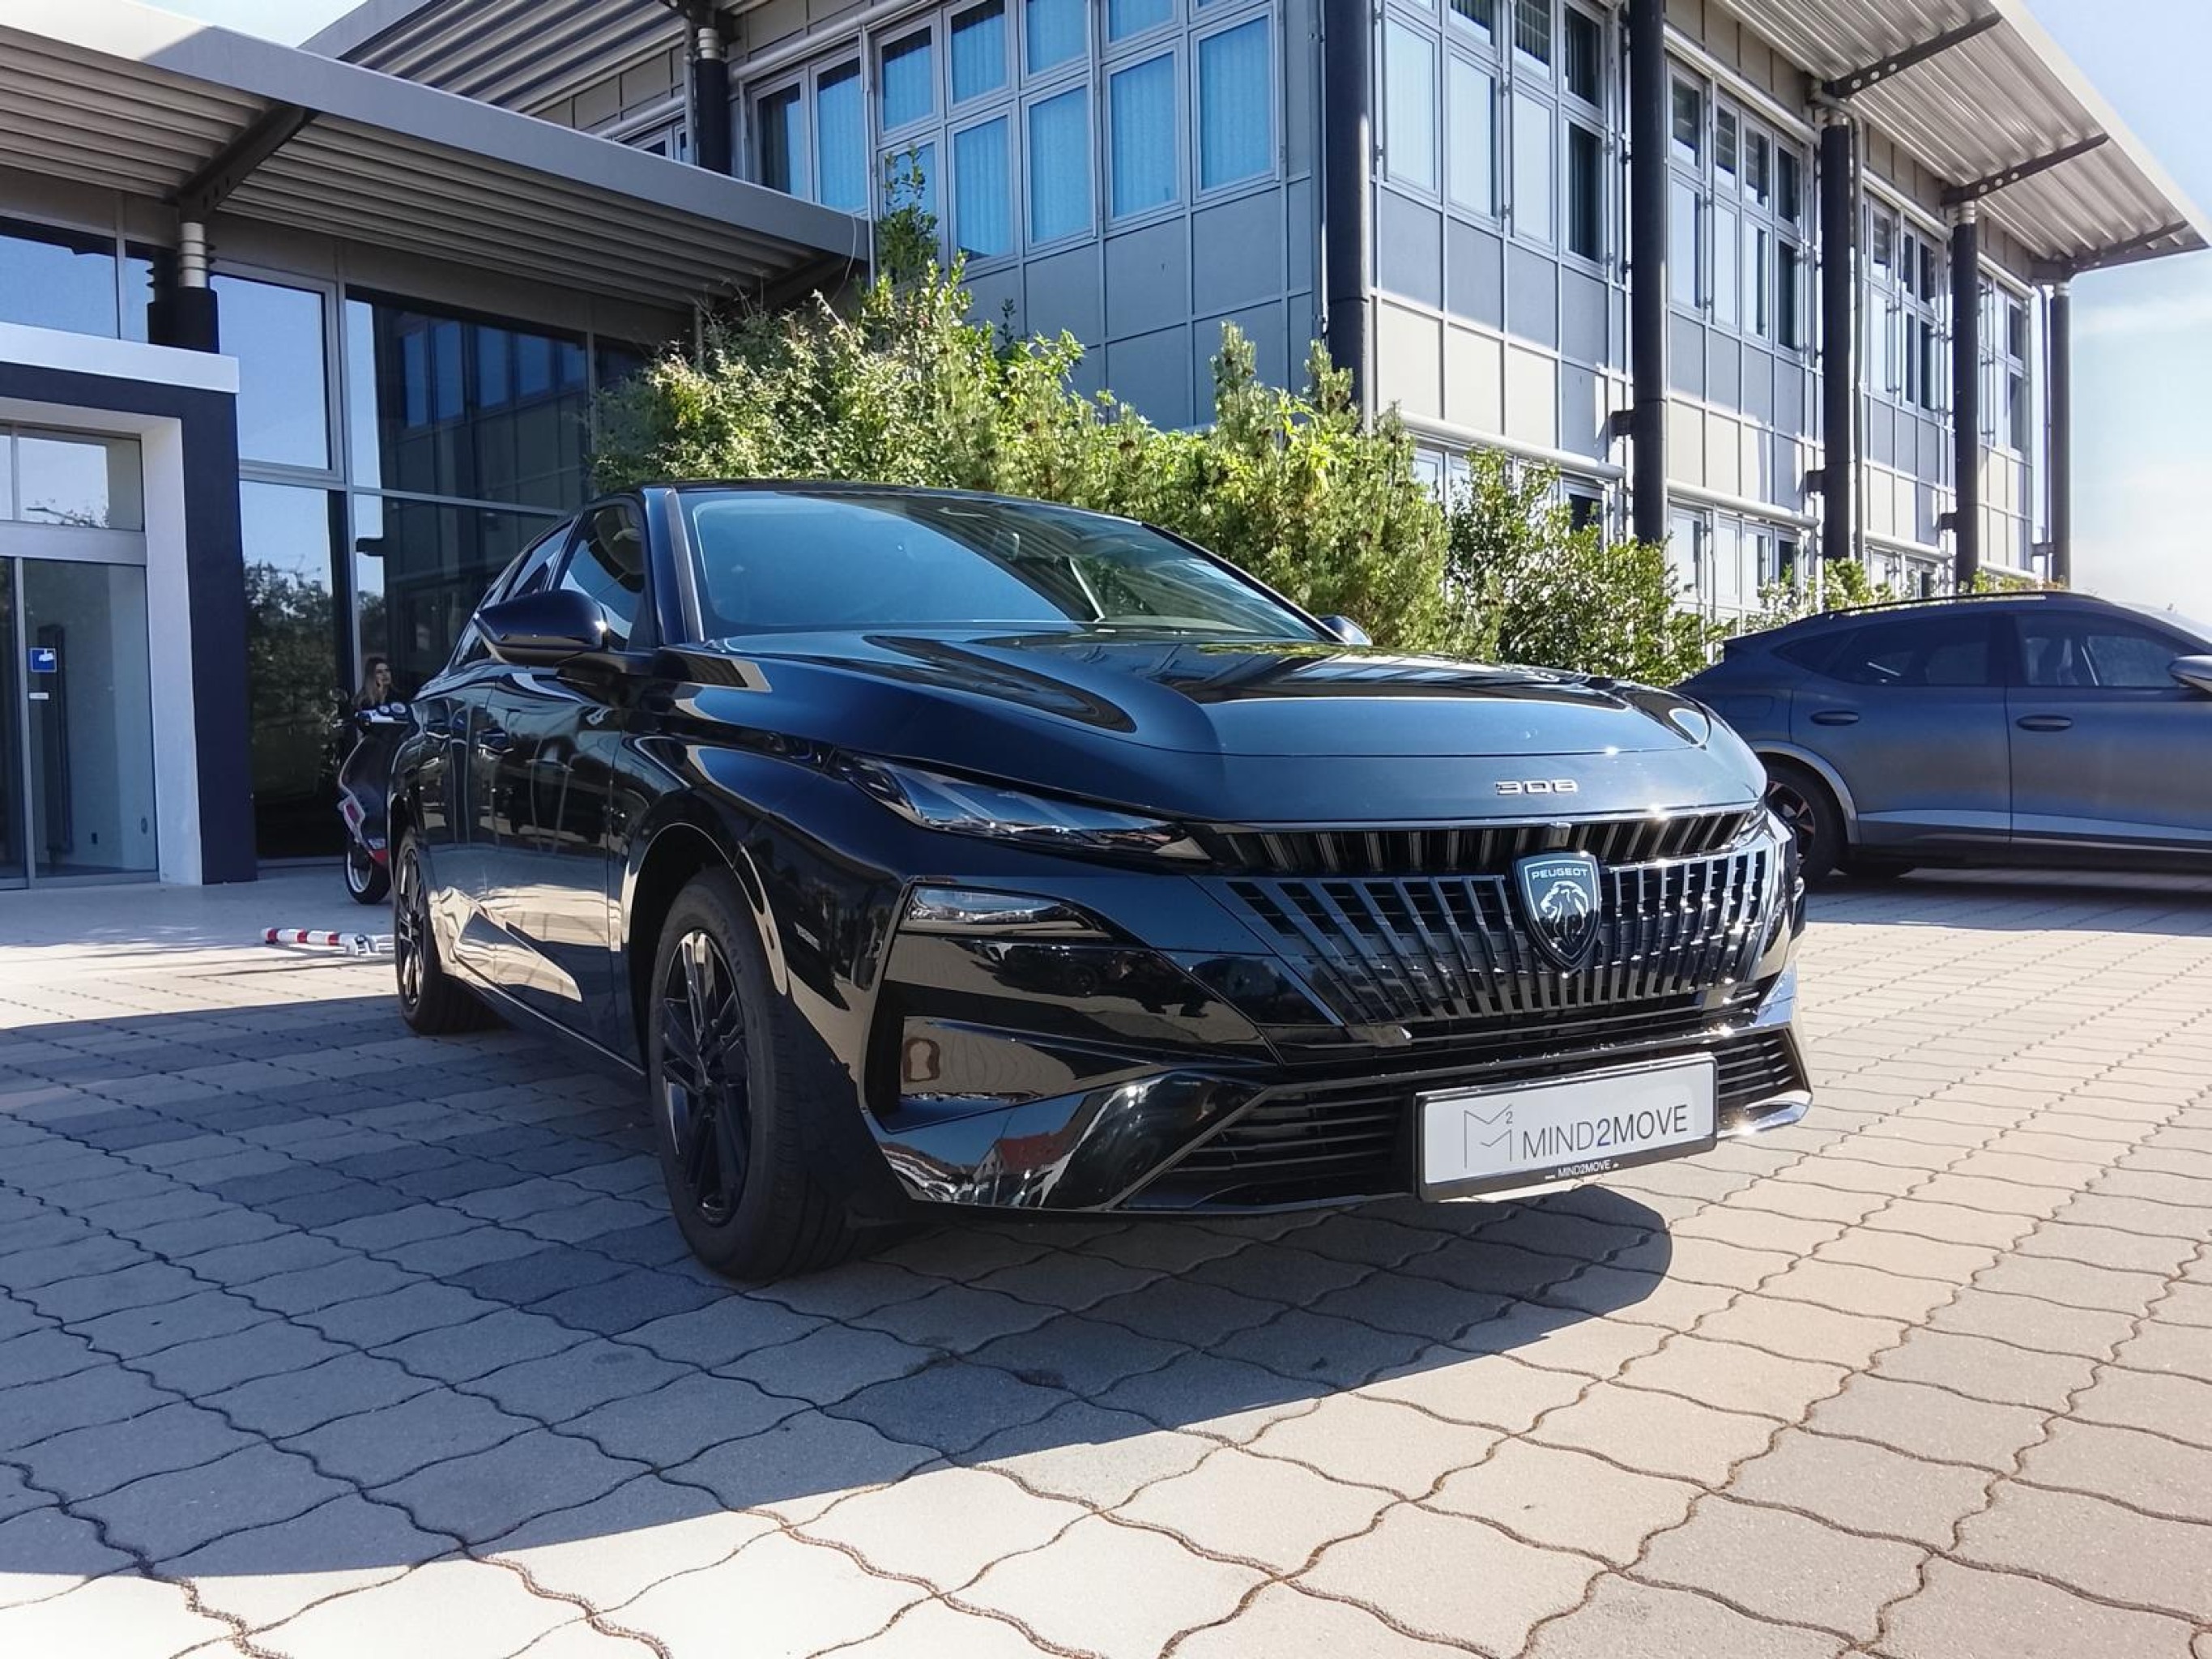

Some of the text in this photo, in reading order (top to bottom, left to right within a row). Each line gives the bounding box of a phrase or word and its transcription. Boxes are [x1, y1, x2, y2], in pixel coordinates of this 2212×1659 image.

[1496, 779, 1577, 795] 308
[1532, 868, 1588, 879] PEUGEOT
[1523, 1104, 1687, 1159] MIND2MOVE
[1558, 1159, 1611, 1178] MIND2MOVE
